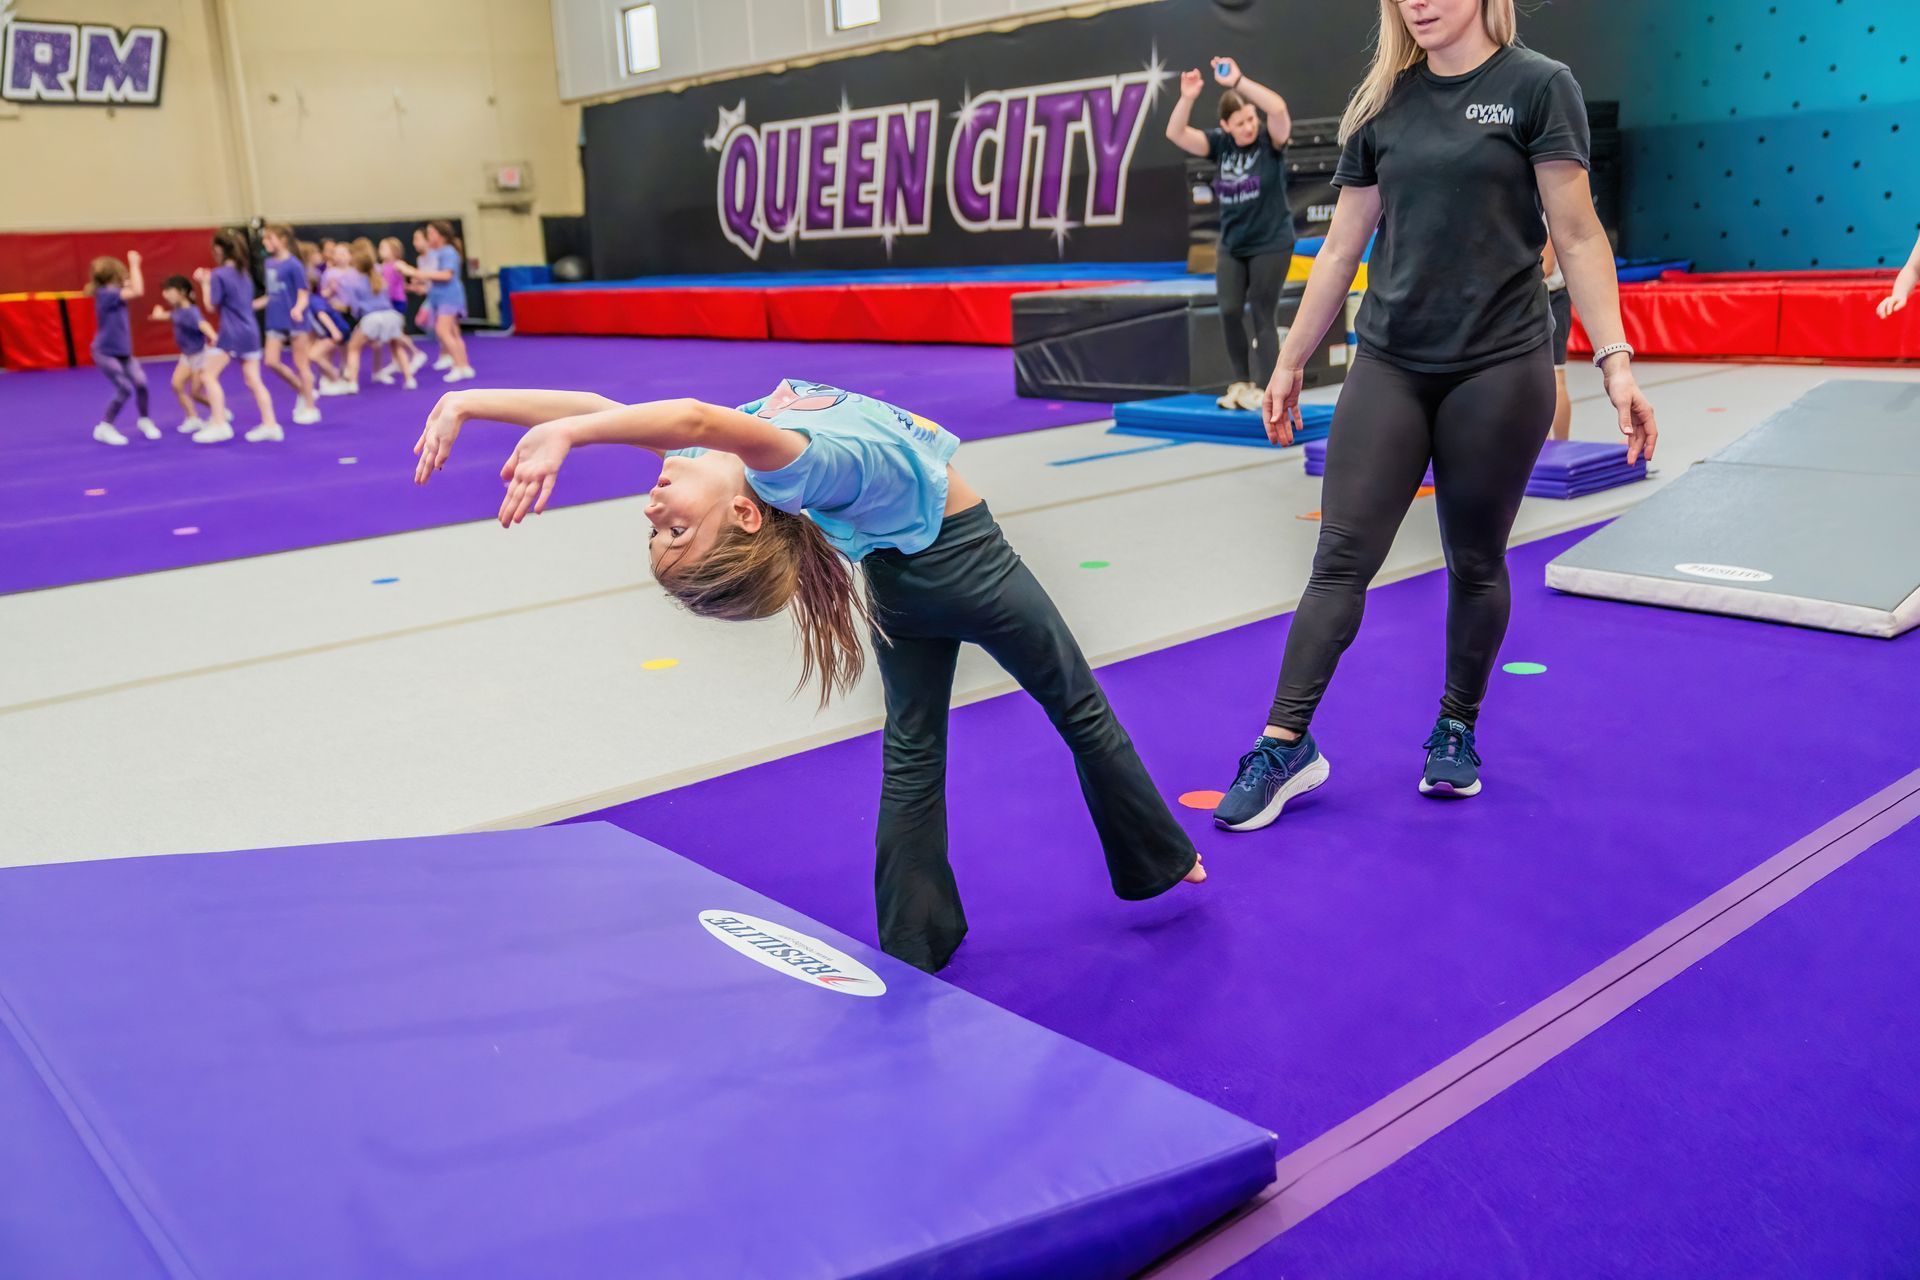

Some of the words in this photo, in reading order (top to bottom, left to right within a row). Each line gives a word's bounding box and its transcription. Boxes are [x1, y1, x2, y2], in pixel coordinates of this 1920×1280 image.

[1465, 103, 1504, 119] GYM
[1478, 107, 1514, 125] JAM
[717, 100, 939, 260] QUEEN
[947, 73, 1153, 231] CITY
[705, 917, 841, 976] RESILITE
